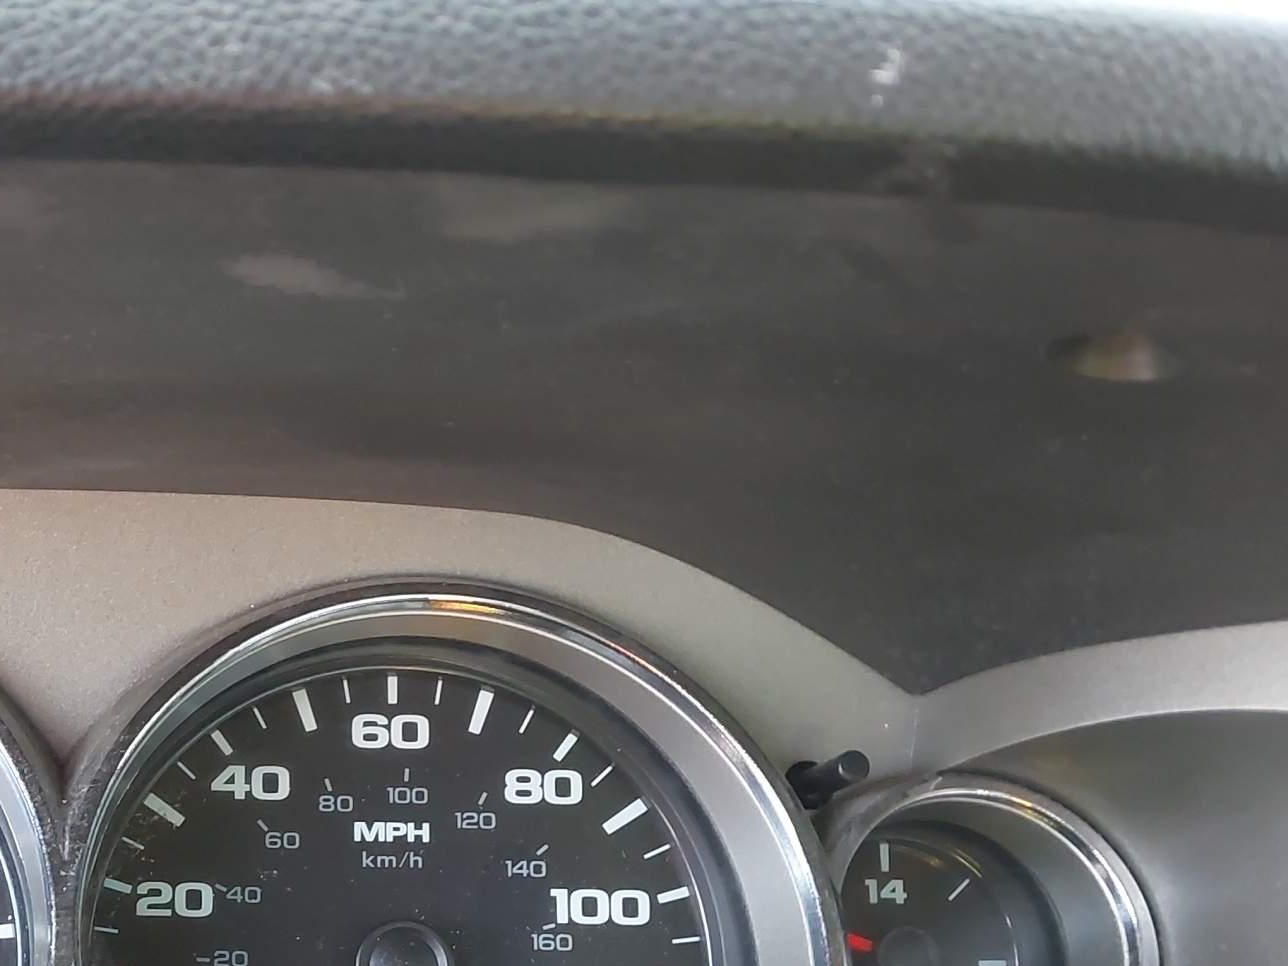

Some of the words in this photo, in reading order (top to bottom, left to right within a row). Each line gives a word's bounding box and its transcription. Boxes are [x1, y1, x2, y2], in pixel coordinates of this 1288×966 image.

[351, 714, 430, 750] 60
[210, 765, 290, 801] 40
[504, 768, 583, 805] 80
[318, 795, 354, 813] 80
[386, 787, 428, 805] 100
[455, 811, 496, 830] 120
[264, 831, 300, 850] 60
[353, 822, 430, 843] MPH
[361, 852, 424, 870] km/h
[506, 859, 547, 878] 140
[135, 882, 214, 918] 20
[225, 886, 262, 904] 40
[865, 879, 908, 904] 14
[551, 888, 651, 927] 100
[531, 933, 573, 952] 160
